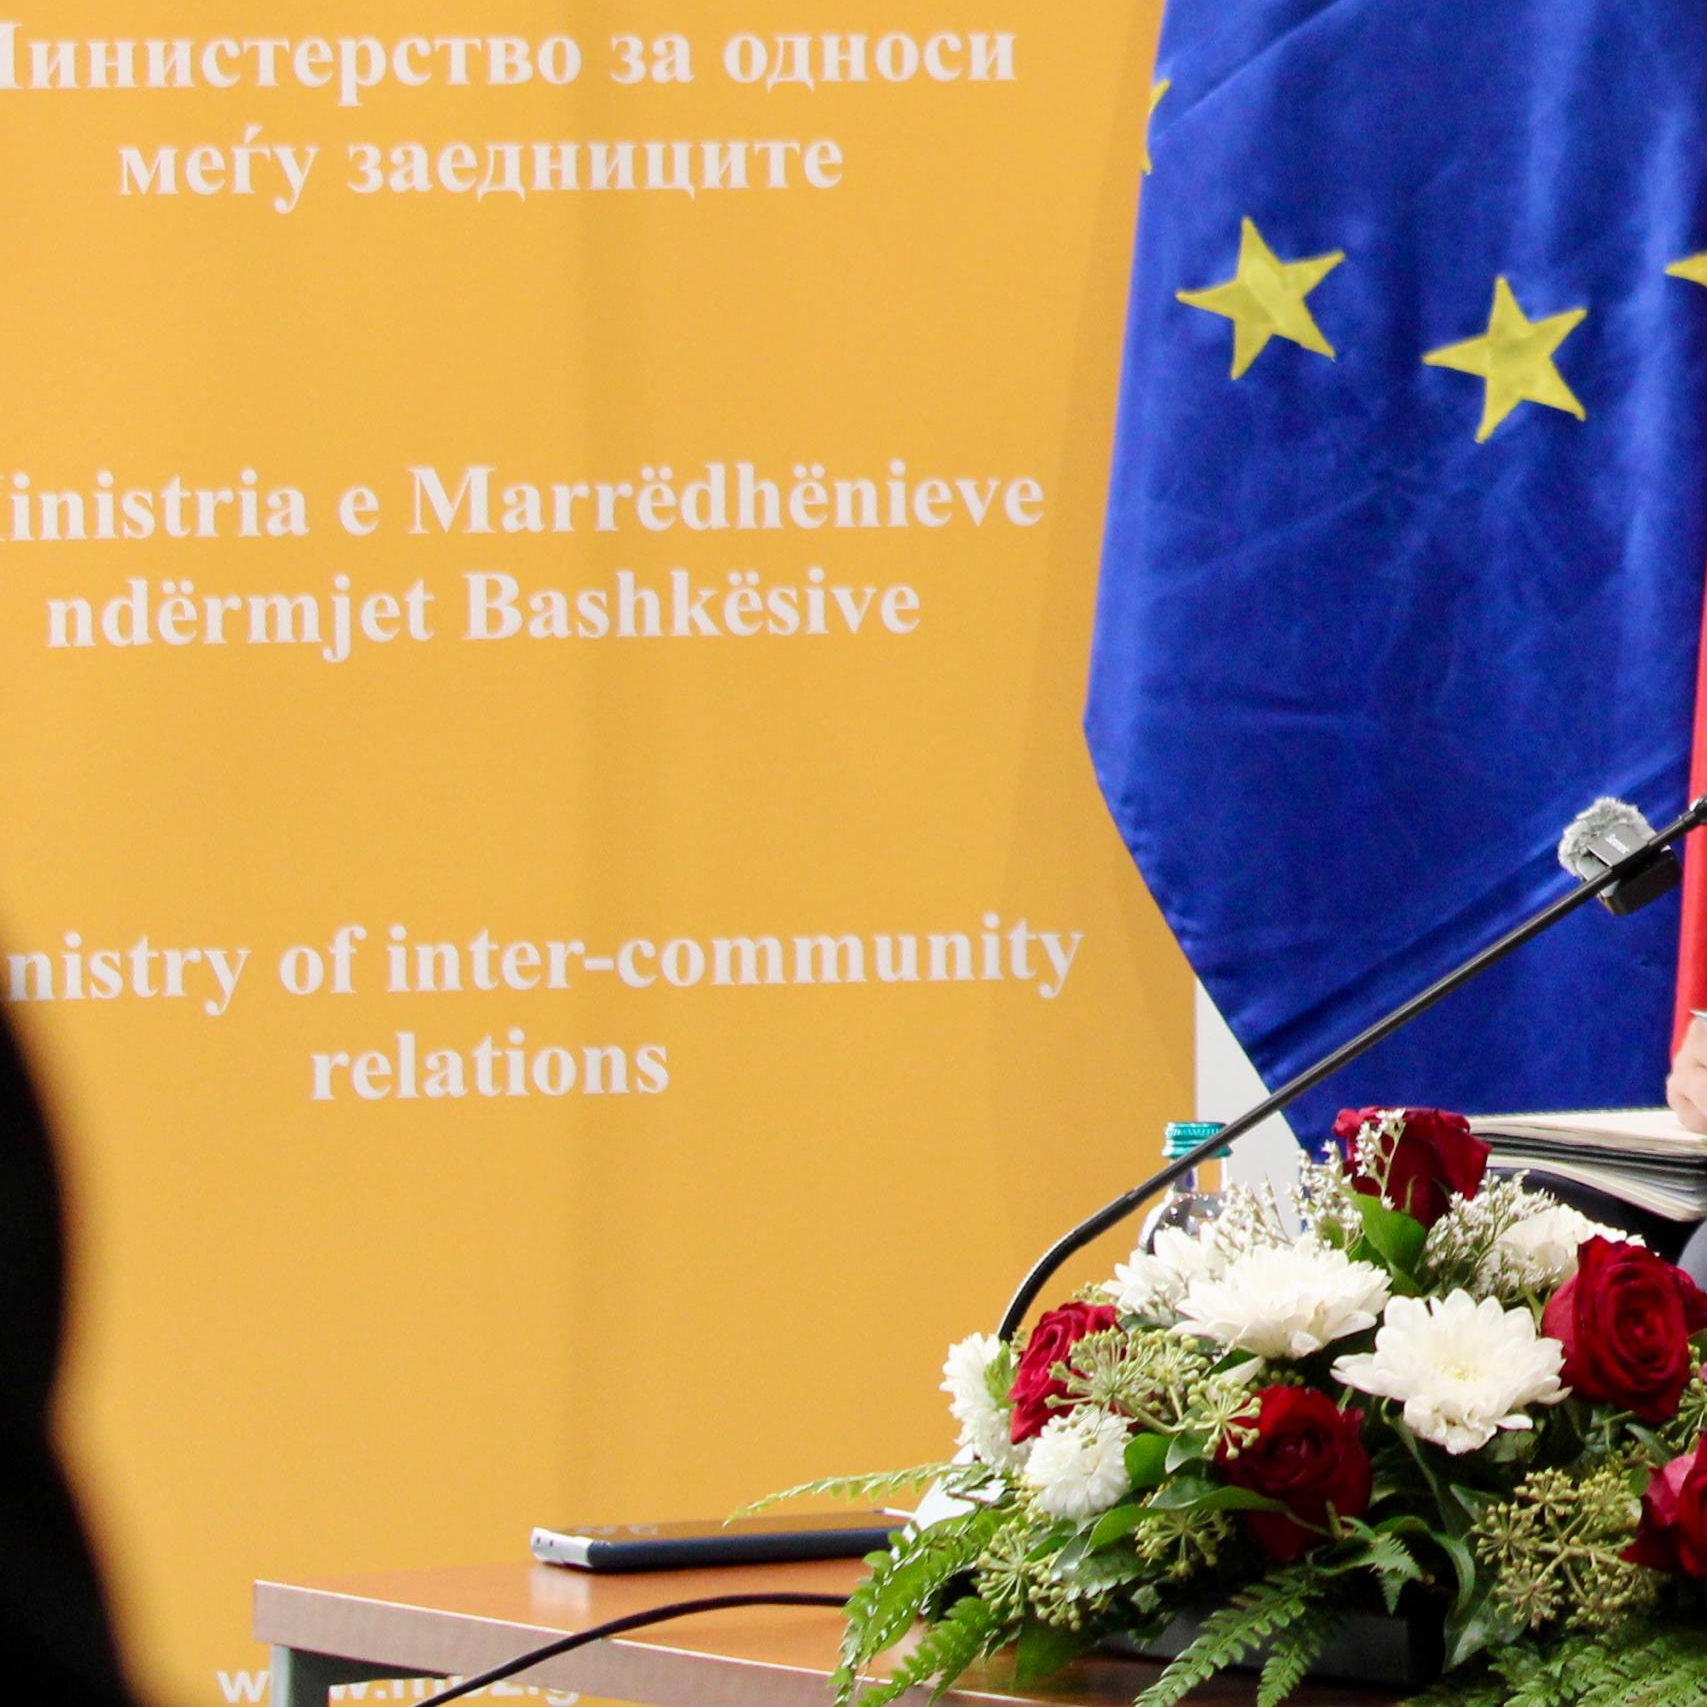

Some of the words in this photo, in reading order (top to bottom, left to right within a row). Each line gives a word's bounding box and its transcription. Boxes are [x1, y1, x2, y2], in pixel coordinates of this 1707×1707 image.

[611, 34, 694, 84] за
[723, 32, 1015, 90] односи
[118, 123, 319, 214] меѓу
[347, 139, 843, 199] заедниците
[0, 468, 309, 541] inistria
[338, 486, 379, 536] e
[409, 458, 1044, 535] Marrëdhënieve
[47, 573, 434, 663] ndërmjet
[464, 566, 920, 640] Bashkësive
[6, 930, 251, 1016] nistry
[278, 924, 367, 995] of
[387, 912, 1083, 999] inter-community
[311, 1027, 669, 1101] relations
